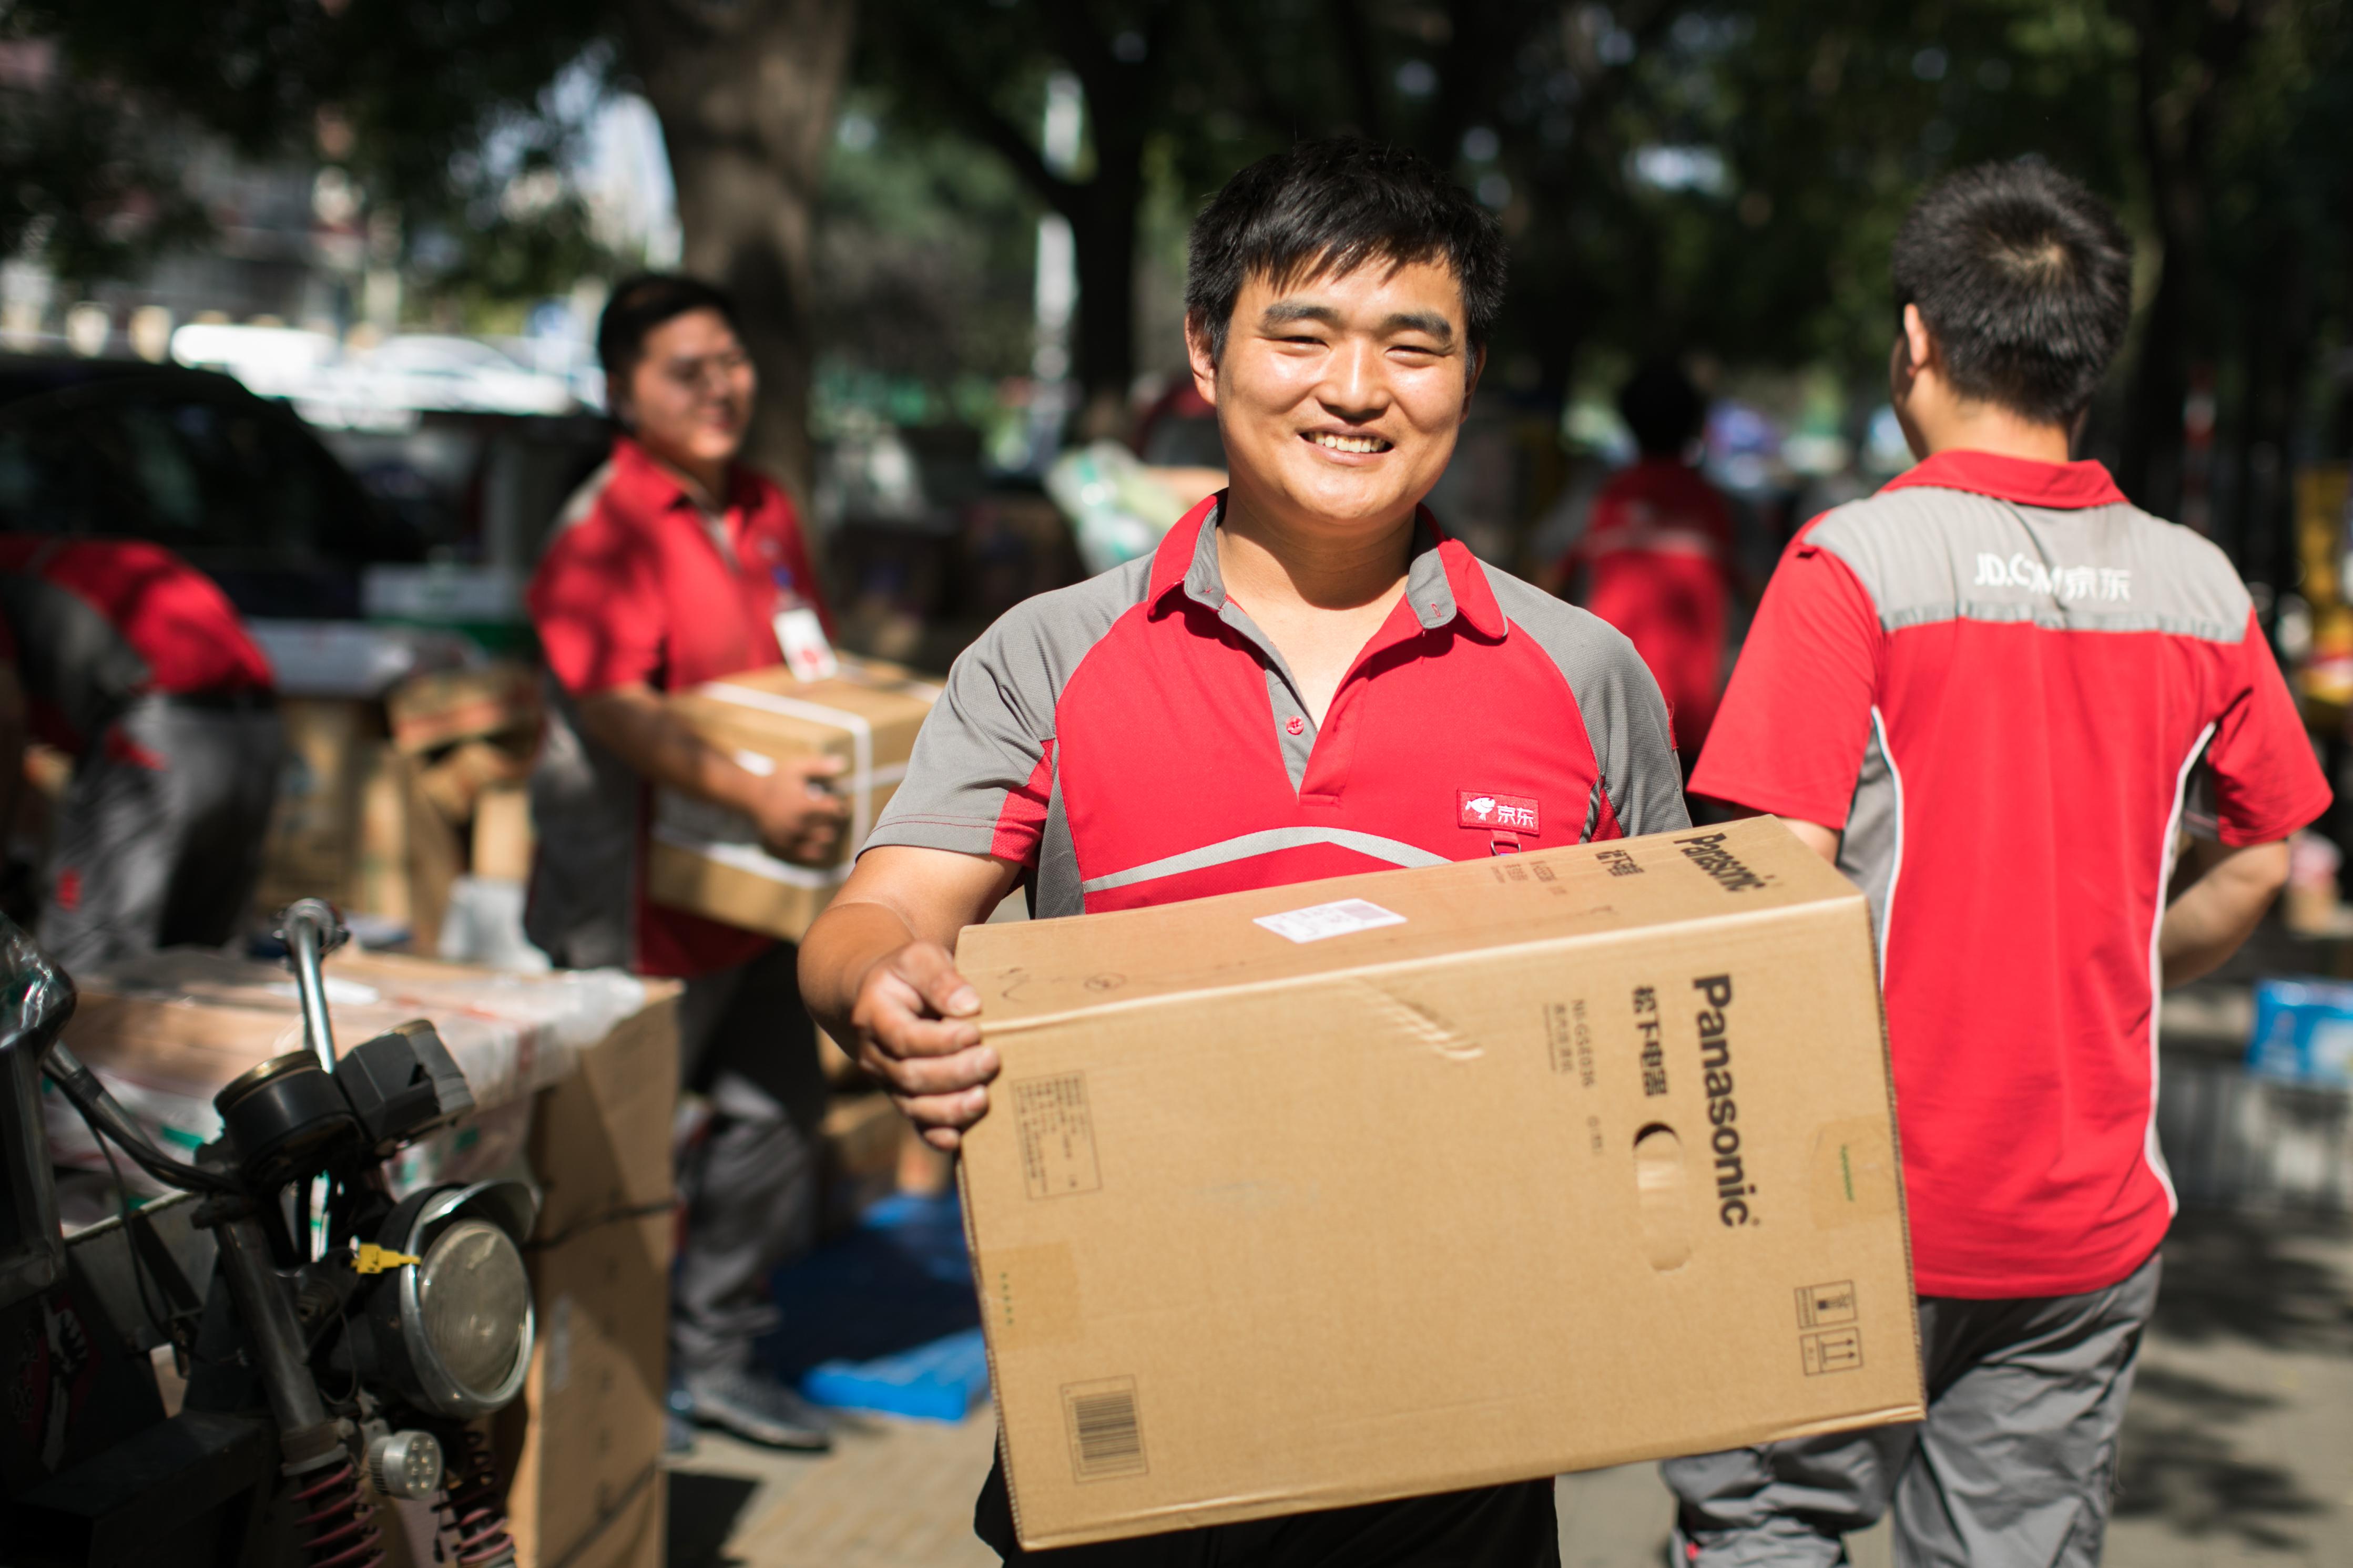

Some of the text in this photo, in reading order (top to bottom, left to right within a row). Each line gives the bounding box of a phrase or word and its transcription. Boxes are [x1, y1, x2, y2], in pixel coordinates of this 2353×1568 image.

[2064, 566, 2132, 602] 京东
[1498, 805, 1534, 827] 京东
[1673, 833, 1776, 891] Panasonic
[1633, 985, 1669, 1097] 松下电器
[1692, 973, 1757, 1228] Panasonic
